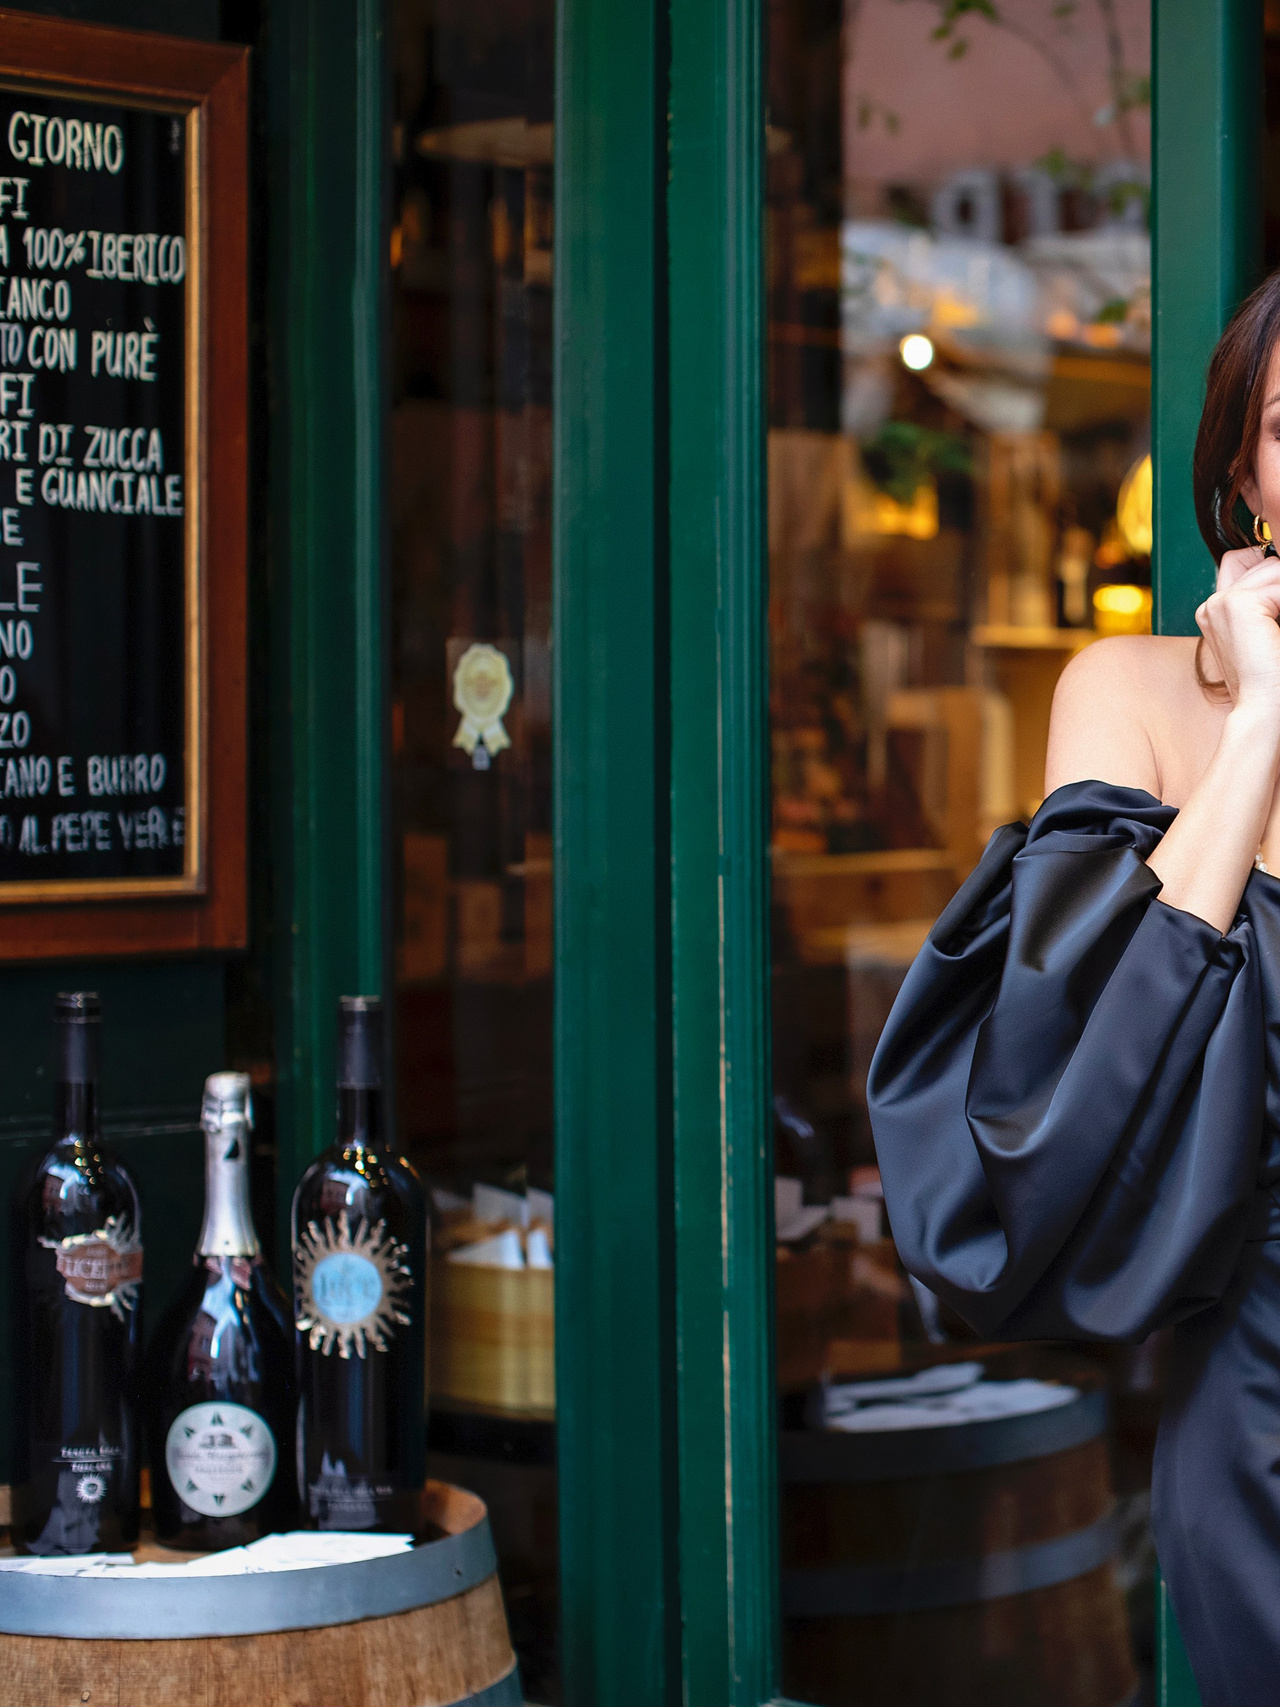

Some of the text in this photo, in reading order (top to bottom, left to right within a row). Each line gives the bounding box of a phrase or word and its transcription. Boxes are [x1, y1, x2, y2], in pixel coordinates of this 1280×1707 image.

[8, 110, 124, 174] GIORNO
[27, 325, 78, 374] CON
[91, 316, 160, 382] PURÈ
[38, 422, 75, 466] DI
[83, 424, 164, 474] ZUCCA
[15, 467, 185, 516] E GUANCIALE
[57, 755, 77, 797] E
[87, 752, 167, 797] BURRO
[18, 814, 49, 857] AL
[51, 809, 113, 852] PEPE
